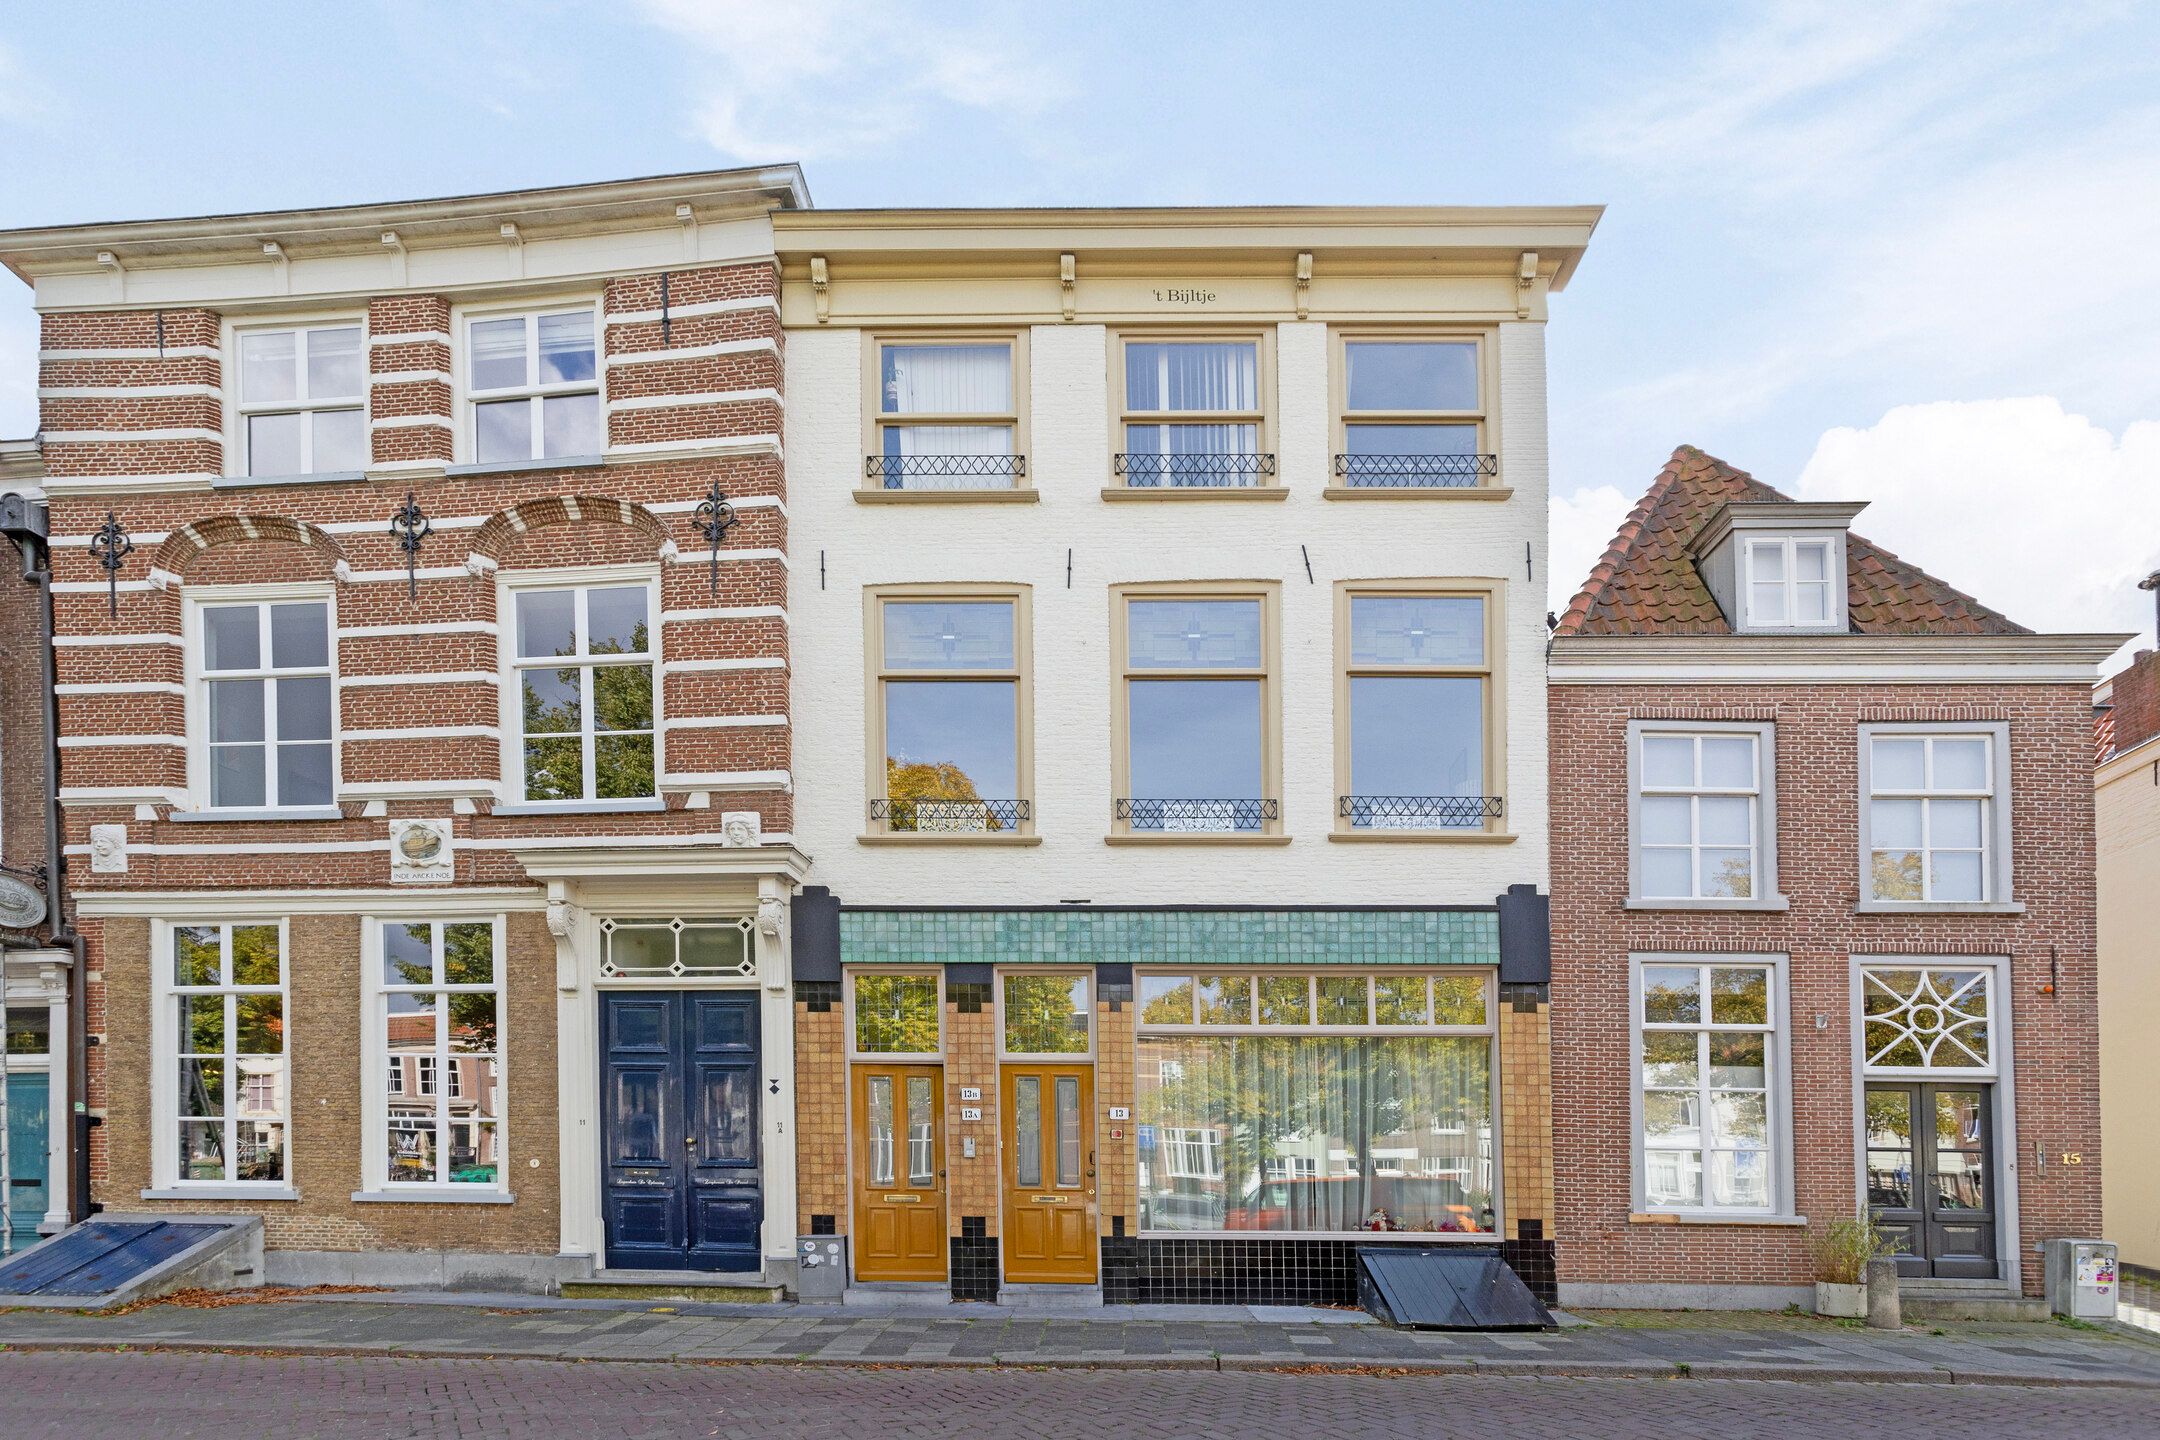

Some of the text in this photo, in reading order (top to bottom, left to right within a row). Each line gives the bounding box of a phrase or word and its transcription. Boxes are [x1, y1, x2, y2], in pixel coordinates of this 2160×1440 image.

[1152, 289, 1216, 304] 't Bijltje
[964, 1110, 979, 1119] 13A
[1115, 1109, 1124, 1118] 13
[2062, 1153, 2081, 1165] 15
